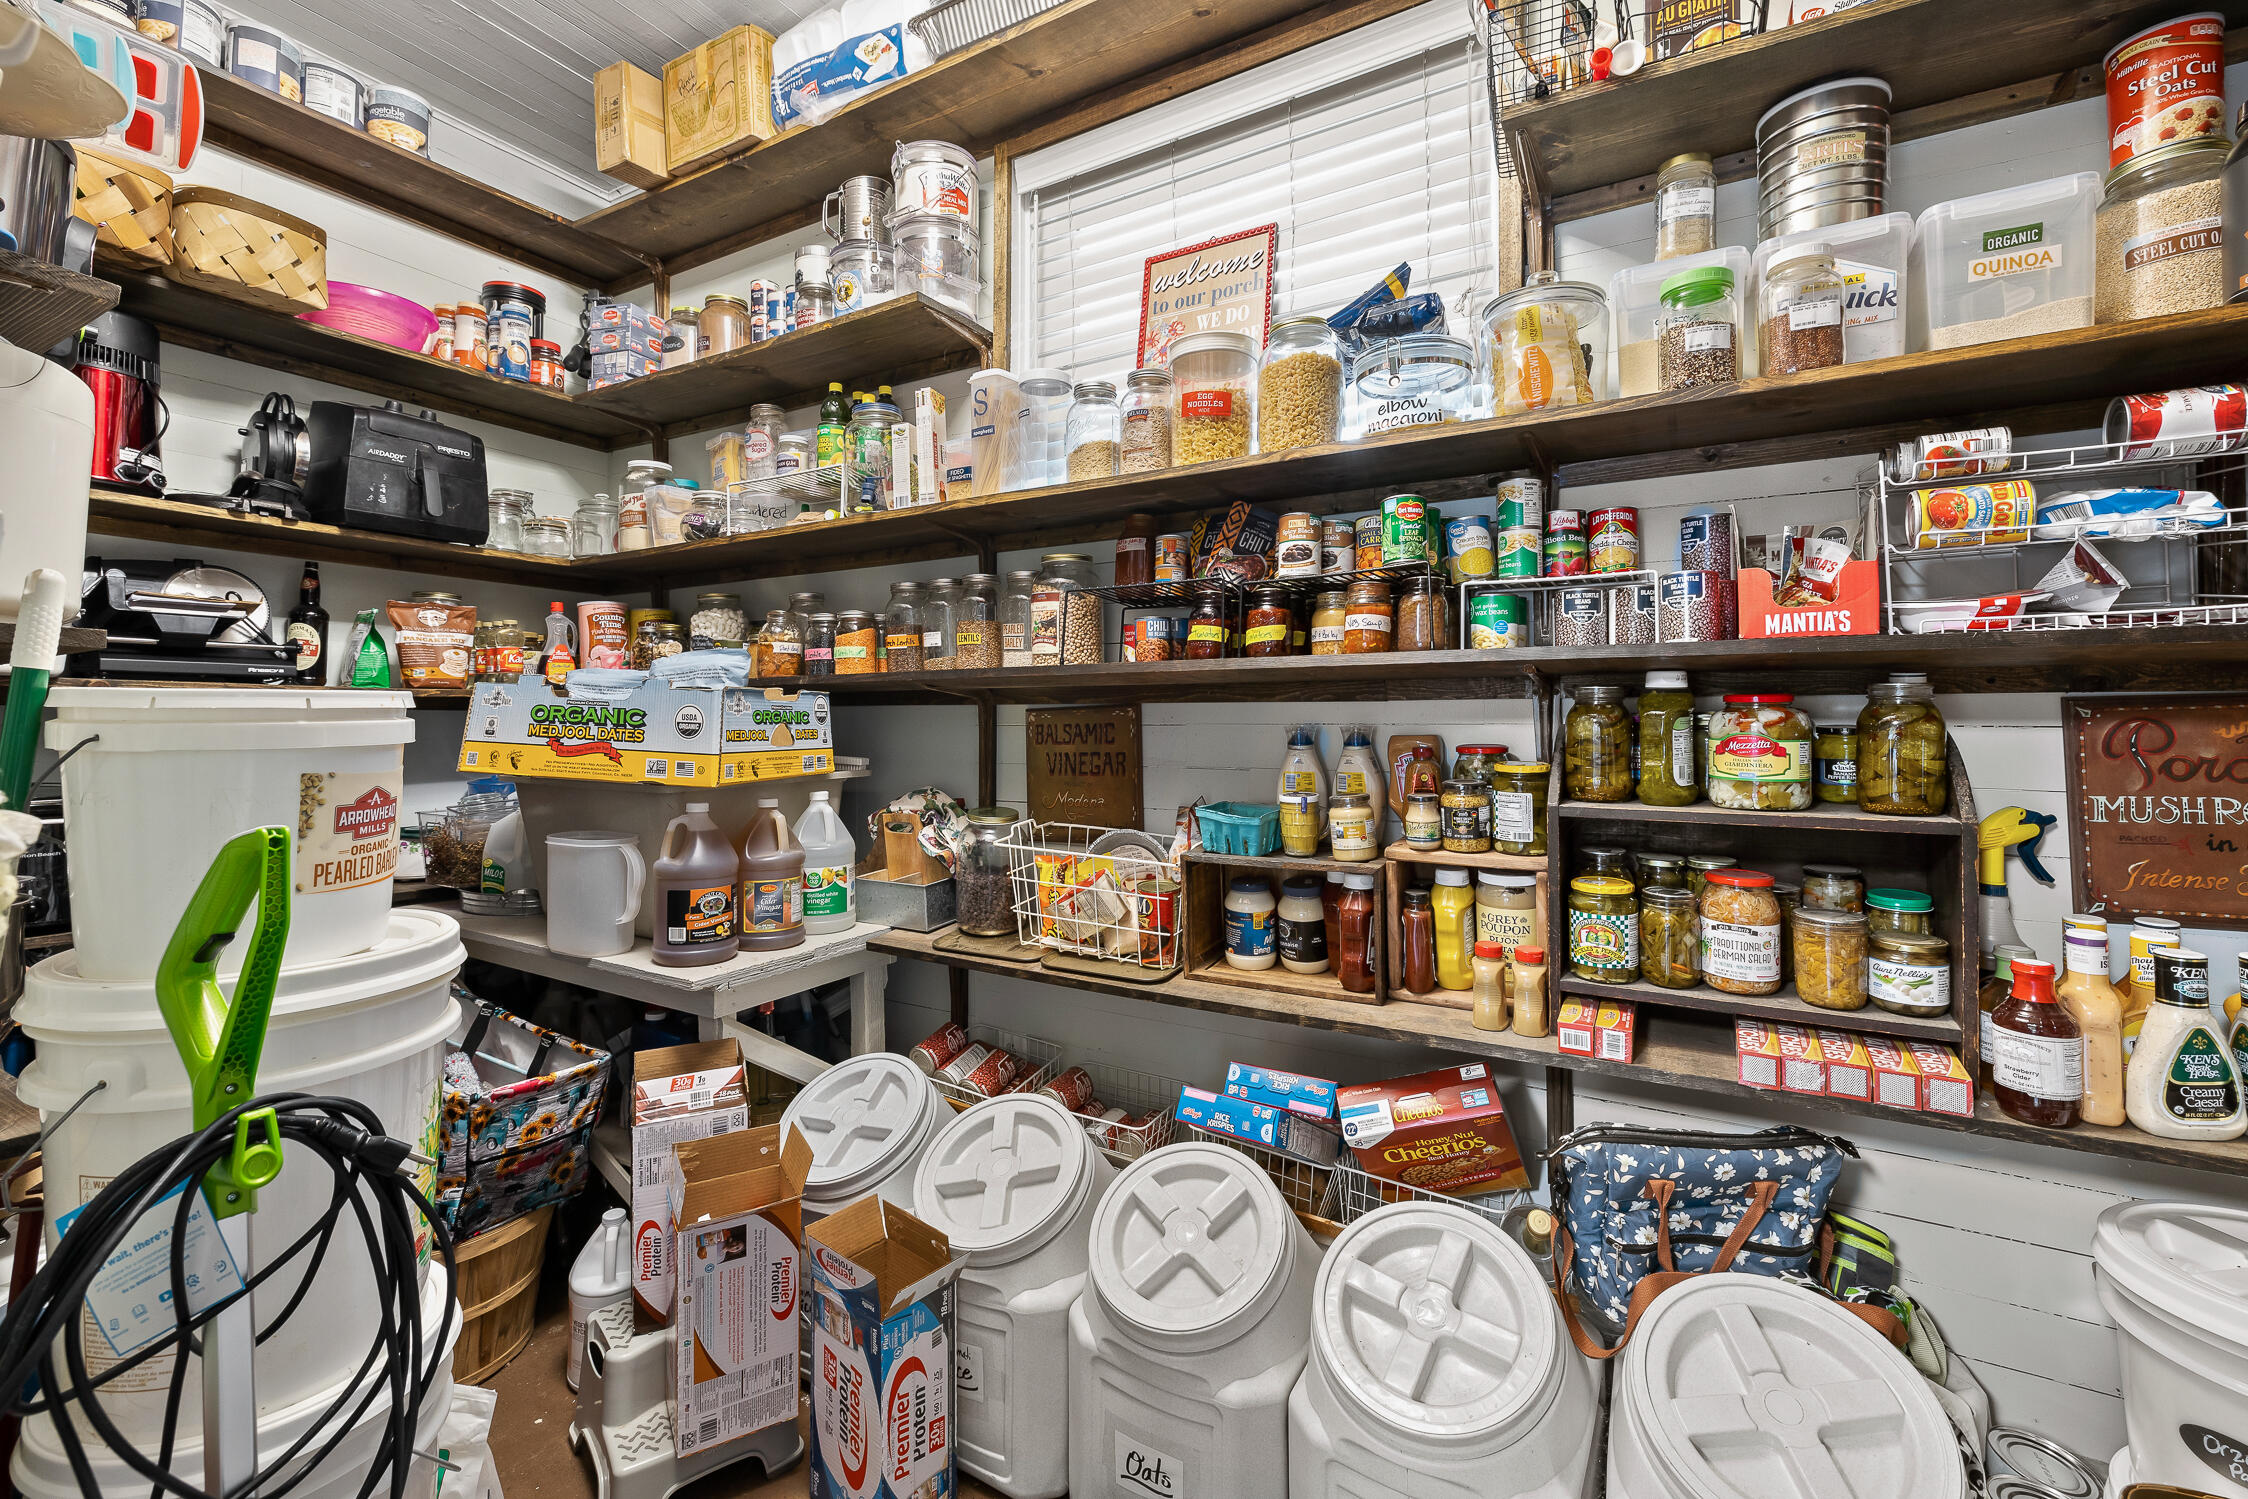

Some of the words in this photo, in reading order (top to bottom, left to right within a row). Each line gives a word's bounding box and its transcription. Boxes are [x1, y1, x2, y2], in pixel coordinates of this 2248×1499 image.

[1803, 8, 1824, 20] IGA
[2118, 44, 2140, 61] WHOLE
[2138, 37, 2162, 50] GRAIN
[2115, 57, 2149, 81] Millville
[2148, 52, 2201, 72] TRADITIONAL
[2127, 65, 2178, 97] Steel
[2185, 60, 2217, 75] Cut
[2154, 78, 2197, 98] Oats
[1801, 139, 1865, 162] GRITS
[1987, 228, 2040, 251] ORGANIC
[2132, 242, 2178, 265] STEEL
[2179, 234, 2208, 250] CUT
[1972, 249, 2054, 278] QUINOA
[1153, 249, 1265, 294] welcome
[1152, 300, 1169, 315] to
[1174, 291, 1206, 310] our
[1210, 271, 1263, 307] porch
[1196, 310, 1221, 331] WE
[1225, 304, 1250, 325] DO
[973, 387, 988, 417] S
[1187, 400, 1224, 408] NOODLES
[1377, 397, 1428, 416] elbow
[1367, 409, 1443, 434] macaroni
[973, 427, 994, 437] spaghetti
[367, 448, 404, 460] AIRDADDY
[437, 445, 471, 457] PRESTO
[1397, 506, 1407, 514] Del
[1407, 505, 1424, 514] Monte
[1553, 515, 1577, 527] Libby's
[1592, 514, 1599, 526] LA
[1599, 513, 1634, 524] PREFERIDA
[1685, 519, 1704, 527] TURTLE
[1404, 528, 1419, 537] LEAF
[1450, 525, 1465, 533] Great
[1475, 534, 1489, 542] Style
[1568, 534, 1587, 542] Beets
[1589, 540, 1615, 550] Cheddar
[1615, 538, 1638, 548] Cheese
[1606, 563, 1621, 572] MILD
[1662, 578, 1680, 586] BLACK
[1680, 575, 1700, 584] TURTLE
[1670, 582, 1688, 590] BEANS
[1565, 592, 1582, 600] BLACK
[1582, 592, 1600, 600] TURTLE
[592, 613, 626, 623] Country
[598, 621, 622, 629] Time
[1764, 609, 1851, 636] MANTIA'S
[1003, 623, 1024, 635] PEARLED
[957, 633, 980, 645] LENTILS
[1004, 637, 1023, 650] BARLEY
[530, 705, 647, 727] ORGANIC
[681, 713, 698, 722] USDA
[752, 709, 810, 725] ORGANIC
[527, 723, 596, 741] MEDJOOL
[597, 726, 645, 742] DATES
[677, 722, 701, 730] ORGANIC
[725, 730, 769, 742] MEDJOOL
[794, 729, 819, 741] DATES
[1034, 722, 1115, 746] BALSAMIC
[1725, 739, 1771, 751] Mezzetta
[1045, 751, 1127, 778] VINEGAR
[1724, 761, 1774, 769] GIARDINIERA
[1048, 791, 1105, 810] Modena
[338, 802, 397, 828] ARROWHEAD
[359, 822, 386, 835] MILLS
[2119, 834, 2168, 843] PACKED
[2205, 833, 2239, 853] in
[350, 838, 389, 856] ORGANIC
[313, 855, 373, 888] PEARLED
[375, 846, 398, 876] BARLEY
[2114, 859, 2230, 893] Intense
[760, 897, 777, 905] Cider
[806, 896, 832, 905] vinegar
[709, 914, 730, 925] Vinegar
[1487, 912, 1519, 925] GREY
[1480, 922, 1531, 936] POUPON
[1489, 934, 1520, 945] DIJON
[1712, 936, 1762, 952] TRADITIONAL
[1712, 947, 1747, 964] GERMAN
[1748, 951, 1772, 964] SALAD
[1872, 962, 1894, 973] Aunt
[1895, 967, 1930, 979] Nellie's
[2179, 1053, 2220, 1065] KEN'S
[2003, 1062, 2040, 1078] Strawberry
[2184, 1063, 2211, 1073] Steak
[673, 1077, 693, 1088] 30g
[1267, 1070, 1300, 1085] KRISPIES
[2012, 1072, 2032, 1083] Cider
[672, 1084, 692, 1092] PROTEIN
[718, 1090, 727, 1098] 18
[727, 1088, 741, 1096] Pack
[1271, 1079, 1291, 1092] RICE
[2180, 1086, 2226, 1099] Creamy
[2184, 1097, 2225, 1108] Caesar
[1183, 1106, 1203, 1120] Kellogg's
[1213, 1111, 1231, 1123] RICE
[1393, 1103, 1444, 1124] Cheerios
[1206, 1118, 1236, 1134] KRISPIES
[1414, 1136, 1451, 1148] Honey
[1452, 1130, 1476, 1142] Nut
[1382, 1136, 1487, 1165] Cheerios
[1427, 1153, 1443, 1163] Real
[1443, 1149, 1470, 1160] Honey
[1437, 1171, 1498, 1189] CHOLESTEROL
[640, 1234, 652, 1282] Premier
[650, 1235, 662, 1278] Protein
[827, 1251, 853, 1275] Protein
[825, 1259, 856, 1287] Premier
[771, 1261, 783, 1305] Protein
[780, 1256, 793, 1306] Premier
[940, 1306, 948, 1318] 18
[826, 1351, 837, 1386] 30g
[933, 1370, 941, 1383] 25
[838, 1360, 851, 1450] Protein
[933, 1401, 941, 1417] 160
[850, 1364, 864, 1466] Premier
[913, 1384, 927, 1463] Protein
[894, 1391, 911, 1482] Premier
[929, 1417, 941, 1454] 30g
[1126, 1450, 1172, 1489] Oats
